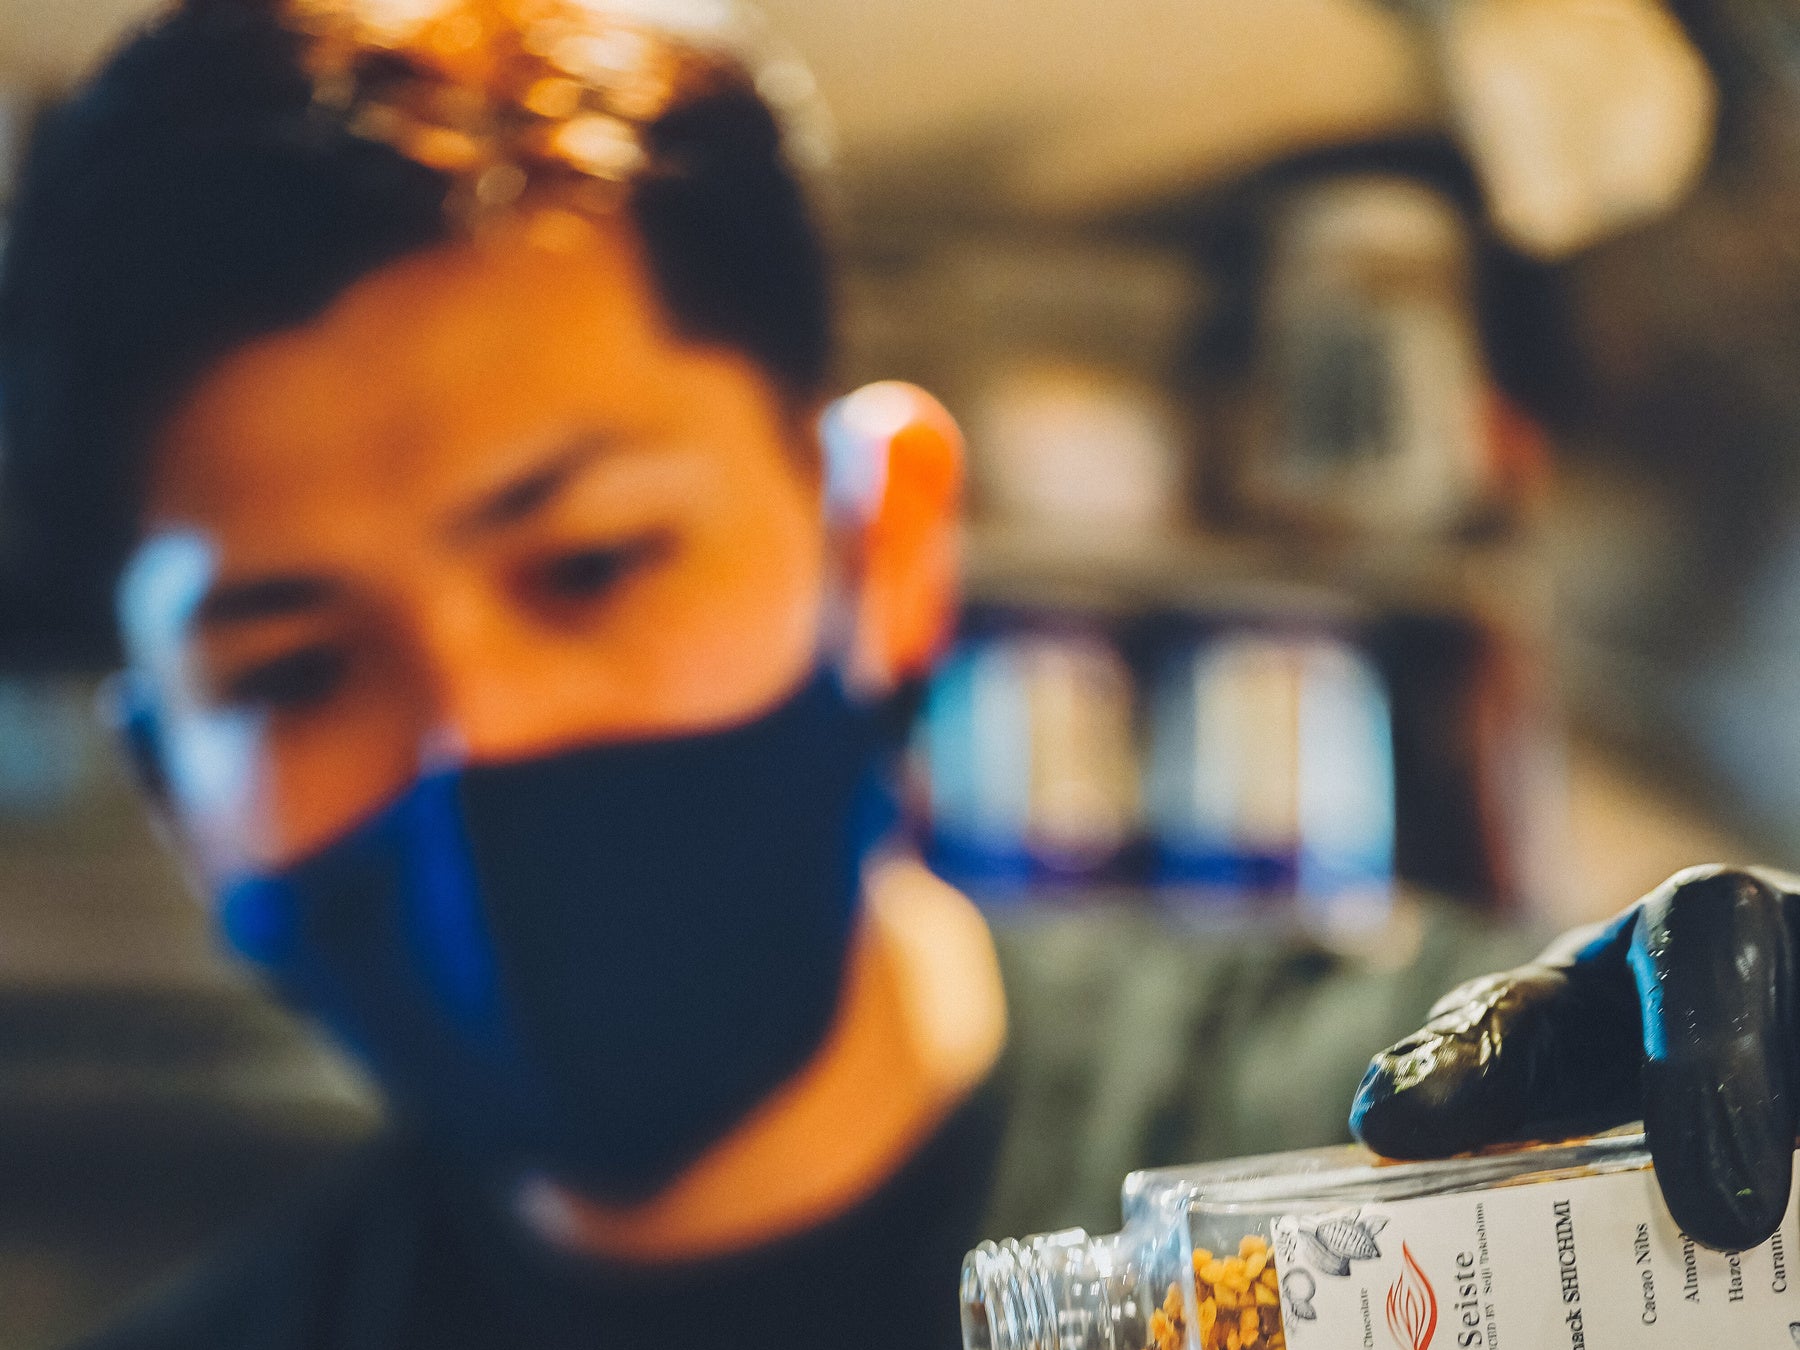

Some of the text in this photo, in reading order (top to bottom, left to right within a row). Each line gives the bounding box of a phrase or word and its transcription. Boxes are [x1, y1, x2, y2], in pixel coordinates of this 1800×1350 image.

[1455, 1250, 1483, 1349] Seiste
[1554, 1199, 1581, 1304] SHICHIMI
[1634, 1222, 1658, 1326] Cacao Nibs
[1485, 1303, 1496, 1320] BY
